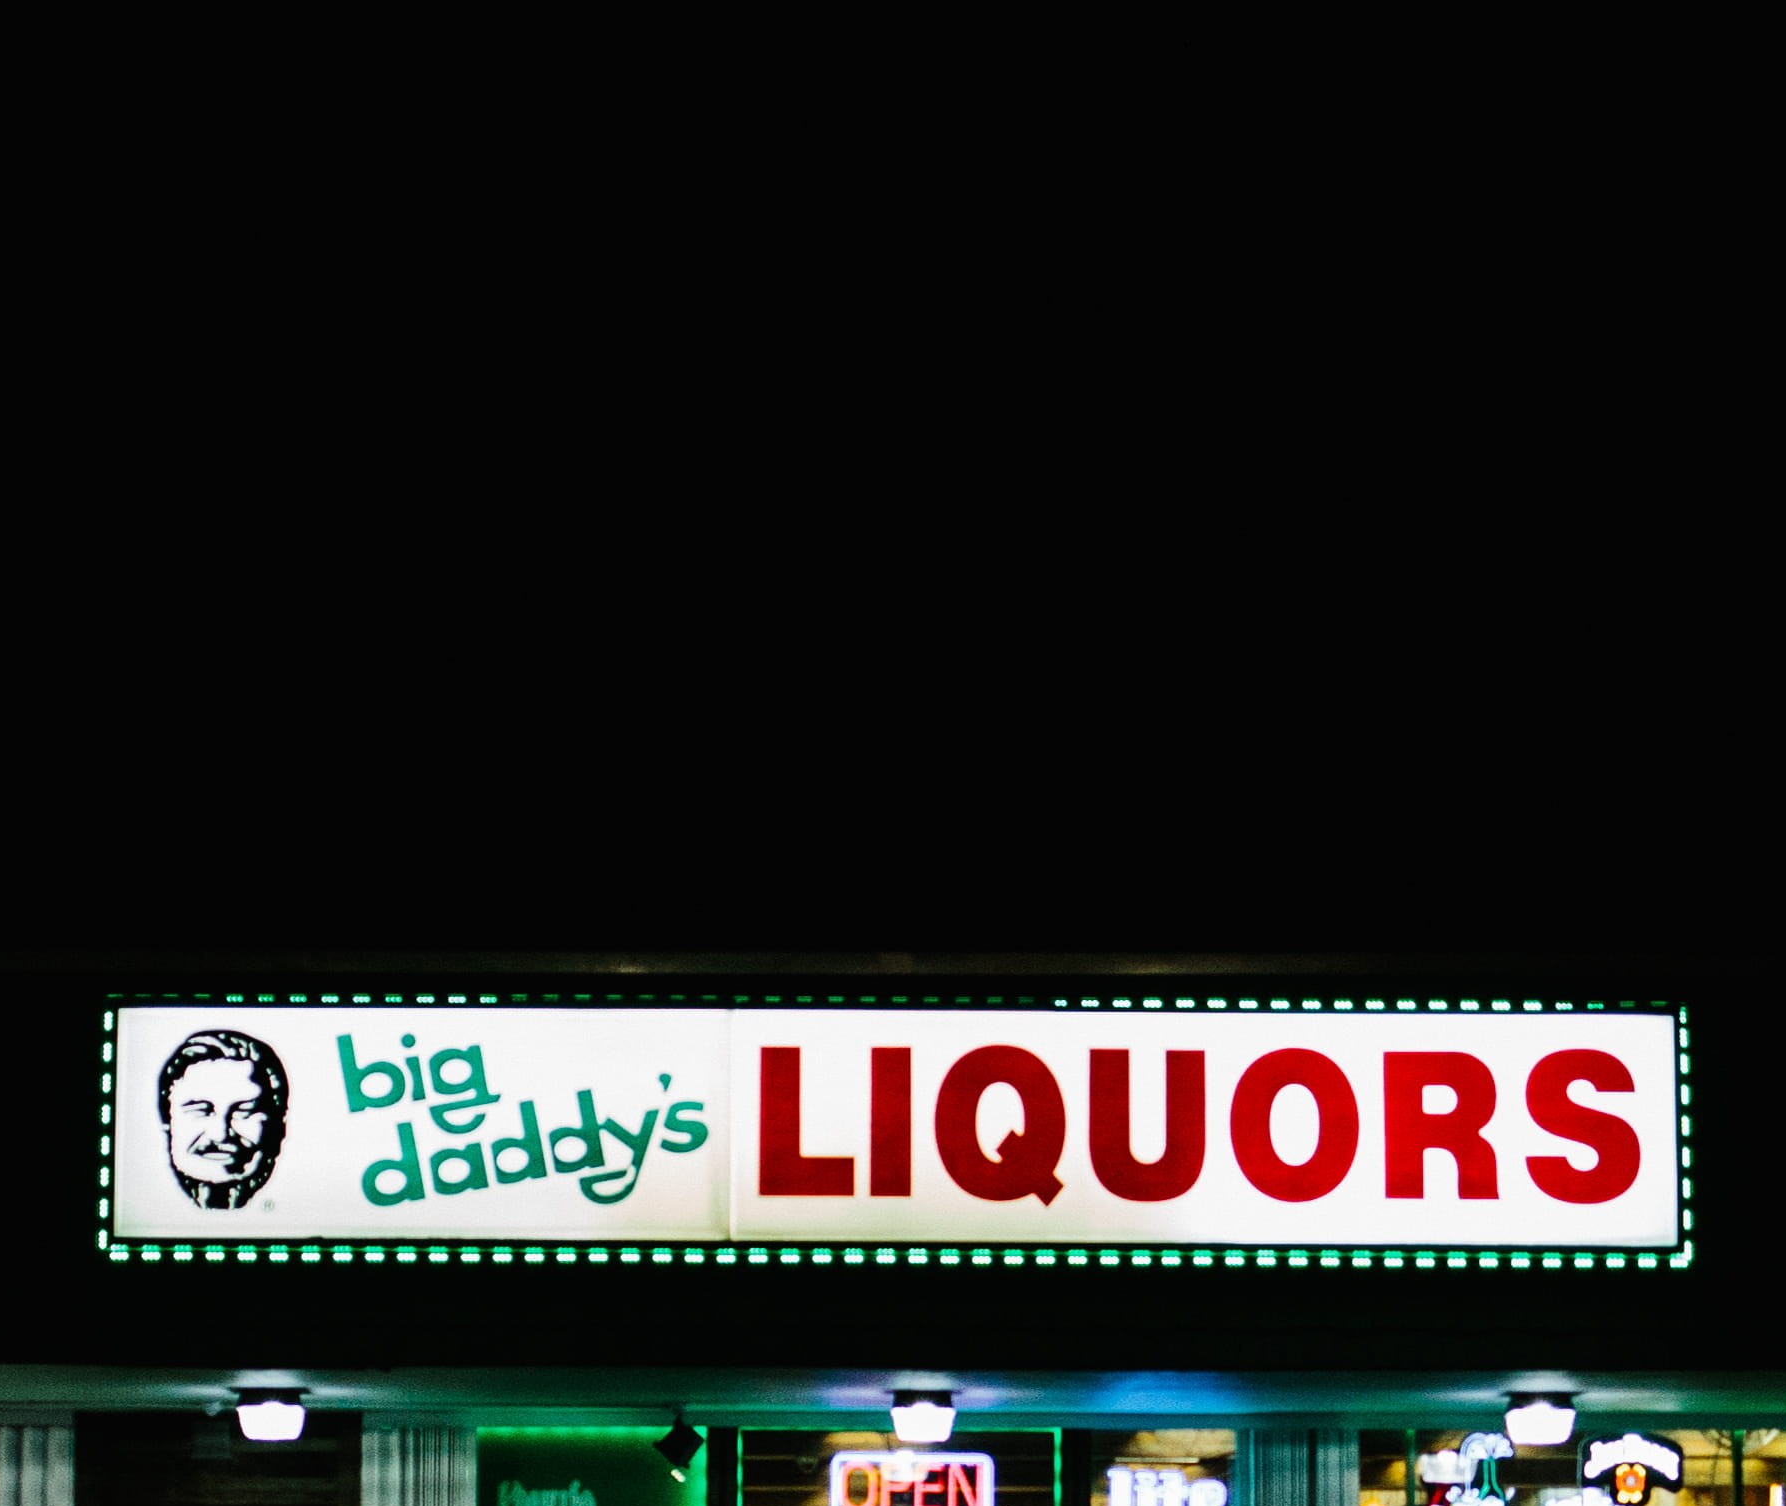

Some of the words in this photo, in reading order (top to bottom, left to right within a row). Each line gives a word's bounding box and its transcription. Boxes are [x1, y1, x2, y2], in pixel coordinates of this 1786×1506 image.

[336, 1033, 502, 1135] big
[361, 1073, 709, 1206] daddy's
[758, 1043, 1642, 1208] LIQUORS
